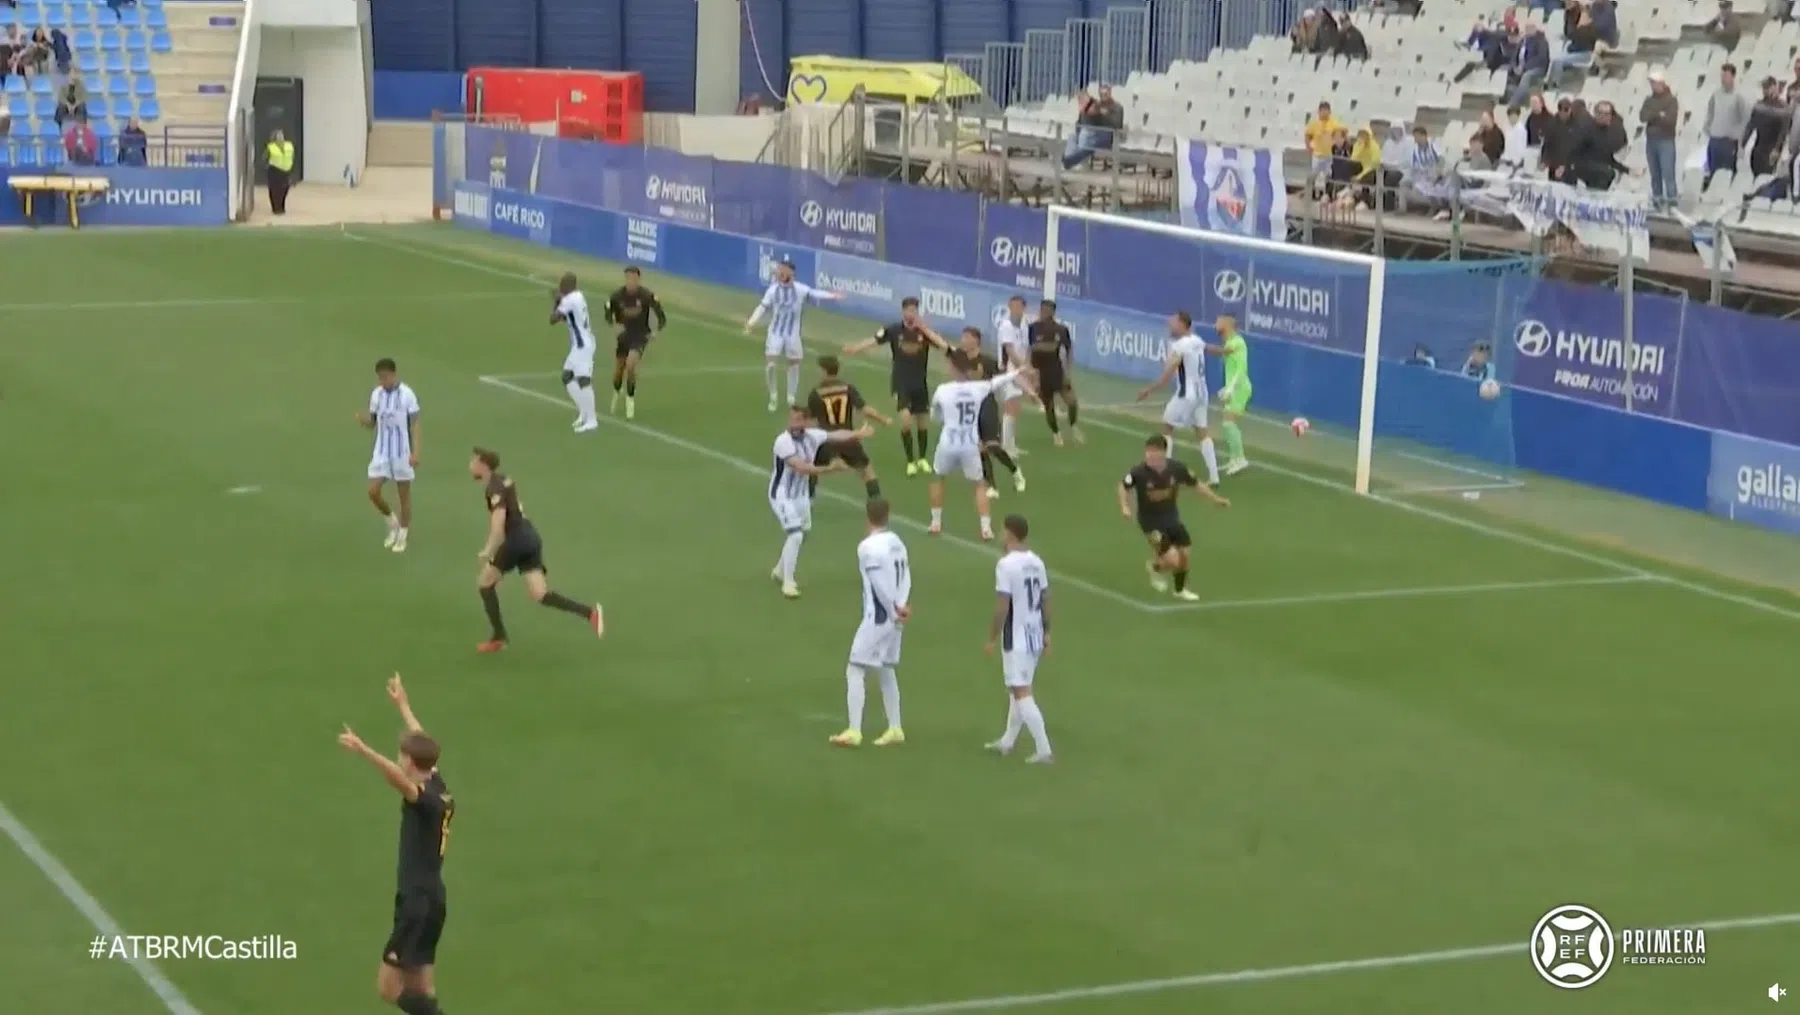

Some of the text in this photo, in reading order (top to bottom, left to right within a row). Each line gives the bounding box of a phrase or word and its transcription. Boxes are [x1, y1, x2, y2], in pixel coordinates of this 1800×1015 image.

[105, 187, 202, 206] HYUNDAI
[494, 200, 520, 225] CAFÉ
[520, 206, 545, 230] RICO
[826, 207, 877, 235] HYUNDAI
[1015, 243, 1081, 277] HYUDAI
[1251, 278, 1330, 317] HYUNDAI
[1555, 329, 1666, 376] HYUNDAI
[821, 394, 849, 426] 17
[956, 400, 976, 426] 15
